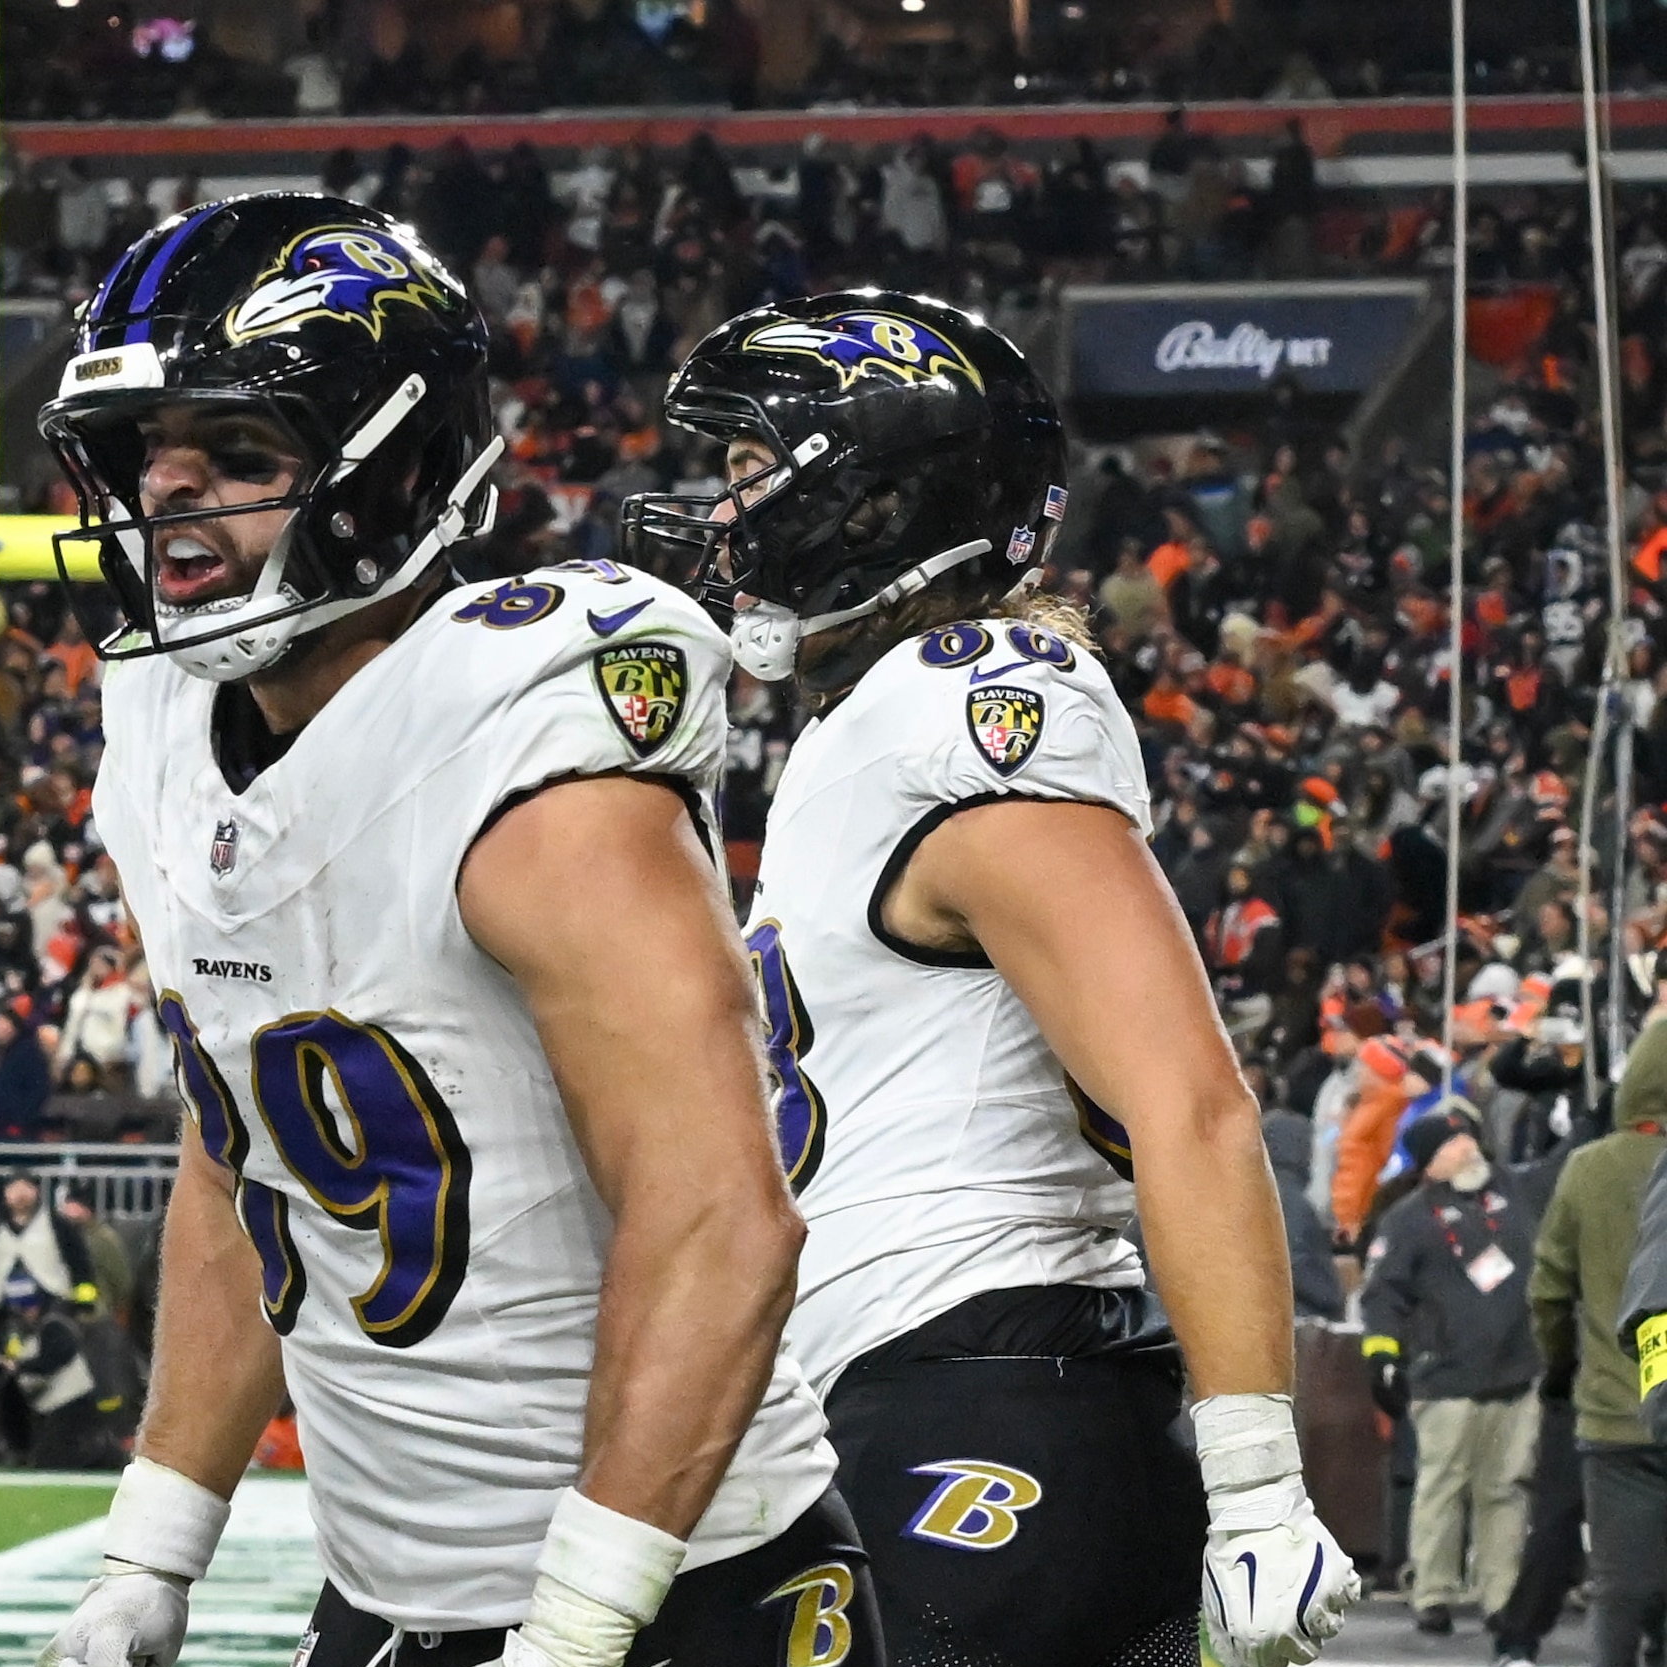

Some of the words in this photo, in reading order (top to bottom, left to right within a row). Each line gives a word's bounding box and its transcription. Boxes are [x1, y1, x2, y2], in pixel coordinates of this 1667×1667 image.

[600, 647, 679, 665] RAVENS
[971, 688, 1037, 704] RAVENS
[192, 958, 273, 982] RAVENS
